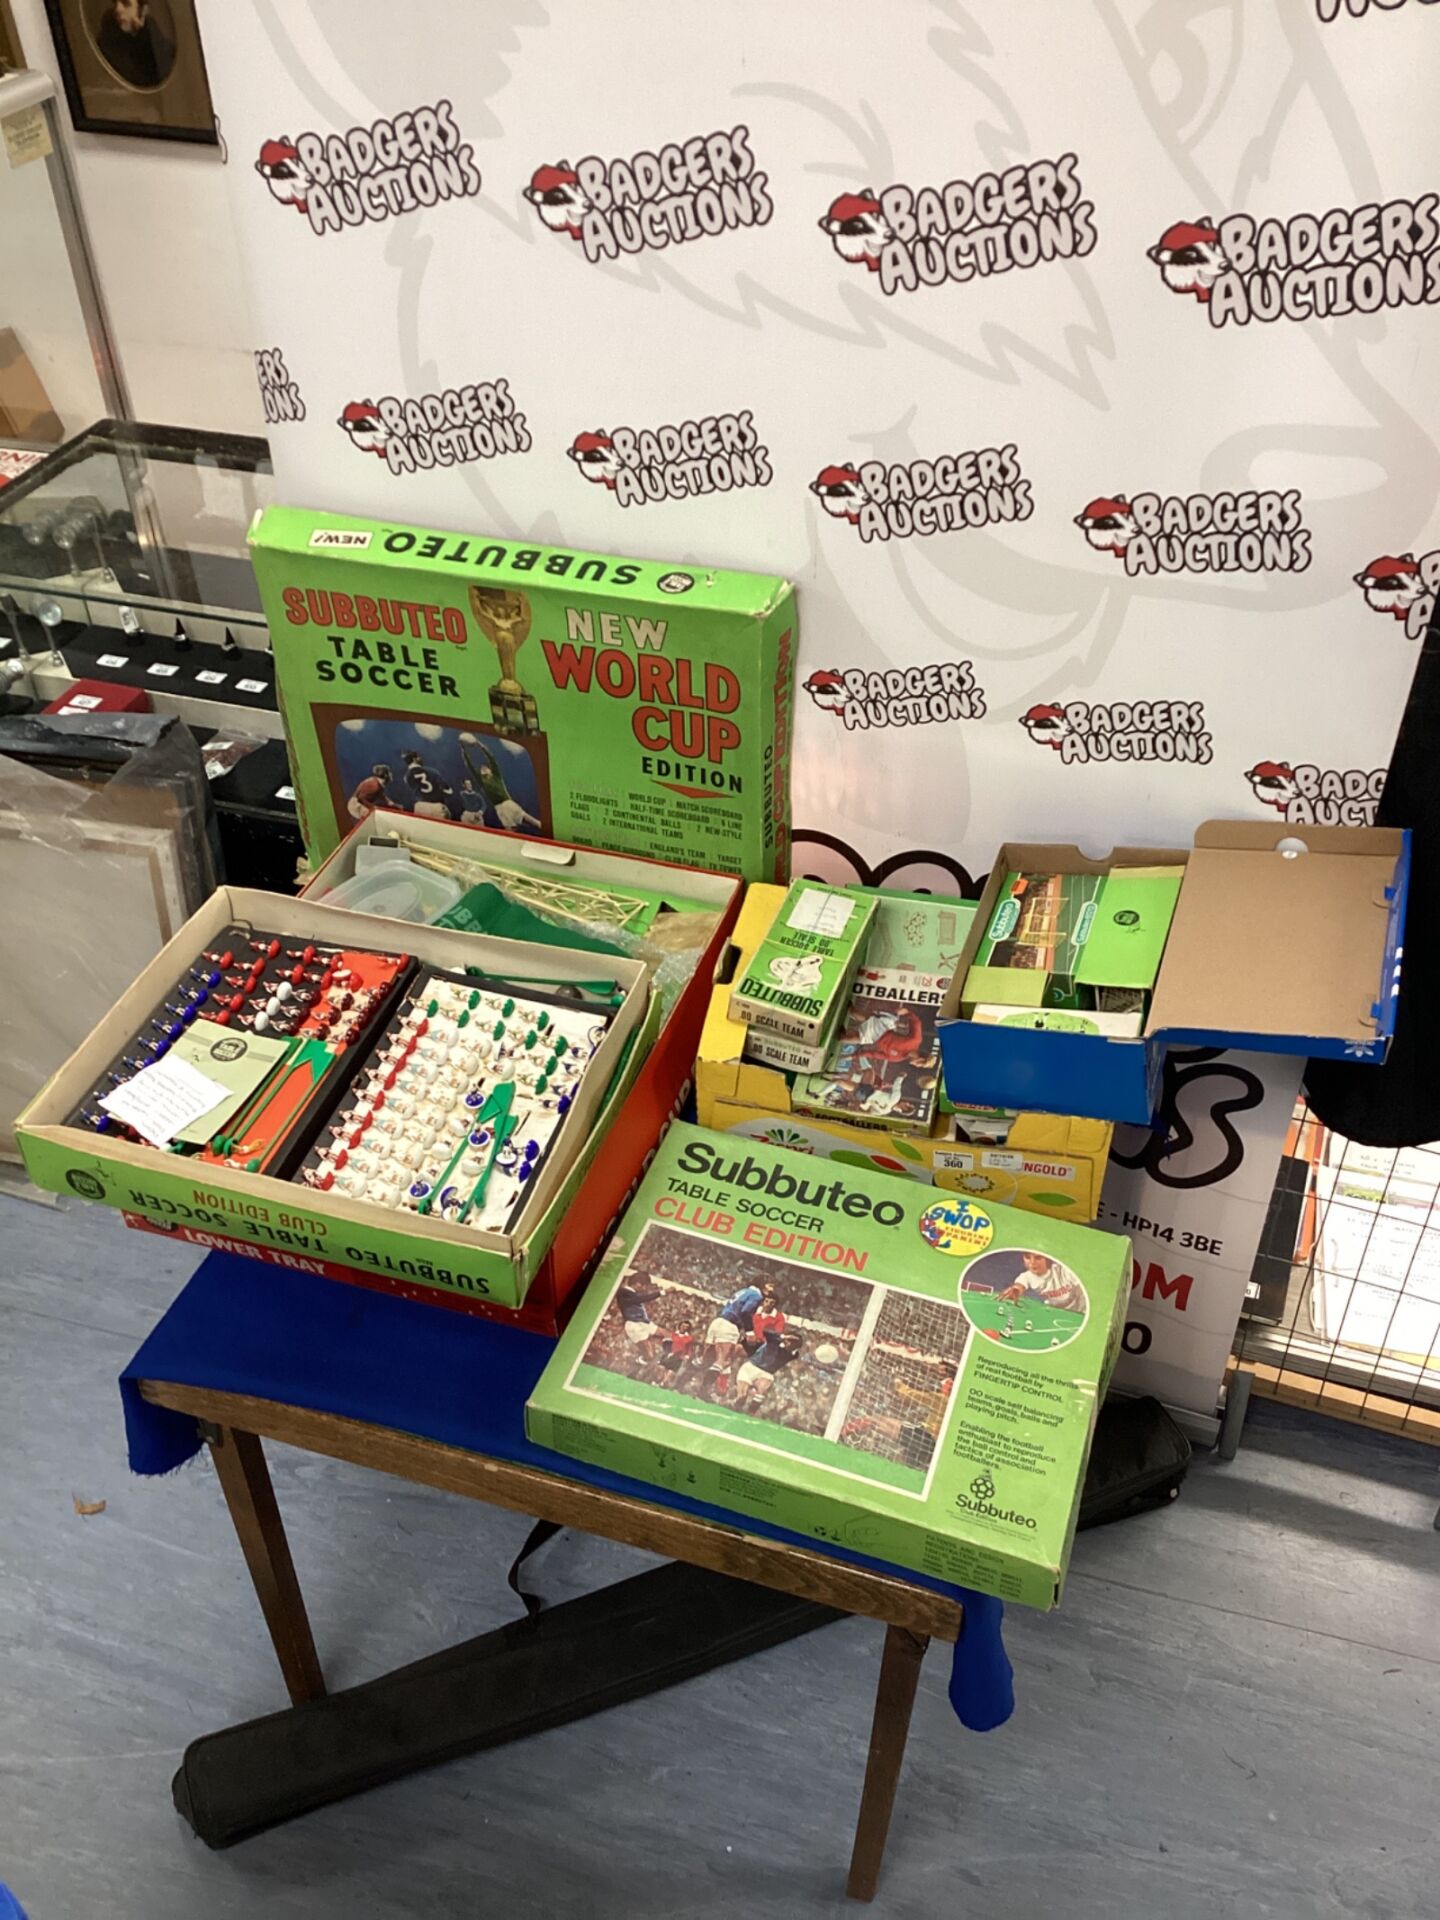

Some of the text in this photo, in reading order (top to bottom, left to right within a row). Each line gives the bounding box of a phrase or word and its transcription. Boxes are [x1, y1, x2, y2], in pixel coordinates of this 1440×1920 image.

[299, 100, 461, 184] BADGERS
[576, 125, 754, 209] BADGERS
[304, 145, 482, 235] AUCTIONS
[878, 153, 1080, 244] BADGERS
[581, 172, 774, 263] AUCTIONS
[1217, 193, 1440, 274] BADGERS
[878, 201, 1097, 295] AUCTIONS
[379, 378, 515, 438] BADGERS
[382, 412, 532, 475] AUCTIONS
[612, 410, 758, 471] BADGERS
[614, 444, 774, 506] AUCTIONS
[857, 444, 1021, 502] BADGERS
[858, 480, 1034, 542] AUCTIONS
[1131, 489, 1302, 537] BADGERS
[314, 535, 367, 546] NEW!
[383, 531, 643, 585] SUBBUTEO
[1124, 528, 1311, 576] AUCTIONS
[283, 586, 468, 645] SUBBUTEO
[565, 606, 668, 652] NEW
[327, 635, 440, 671] TABLE
[315, 659, 461, 698] SOCCER
[540, 639, 741, 715] WORLD
[843, 661, 975, 701] BADGERS
[843, 690, 986, 730] AUCTIONS
[1066, 701, 1205, 735] BADGERS
[632, 705, 742, 765] CUP
[1061, 732, 1213, 764] AUCTIONS
[414, 772, 433, 793] 3
[641, 756, 743, 794] EDITION
[575, 792, 618, 808] FLOODLIGHTS
[667, 808, 710, 824] SCOREBOARD
[727, 820, 742, 830] LINE
[628, 792, 743, 821] WORLD CUP MATCH SCOREBOARD
[764, 744, 774, 849] SUBBUTEO
[570, 802, 590, 812] FLAGS
[613, 809, 656, 826] CONTINENTAL
[660, 818, 681, 829] BALLS
[722, 828, 742, 840] STYLE
[570, 811, 591, 822] GOALS
[608, 818, 658, 836] INTERNATIONAL
[661, 827, 684, 839] TEAMS
[687, 847, 706, 859] TEAM
[717, 854, 742, 864] TARGET
[739, 977, 824, 1018] SUBBUTEO
[755, 1013, 779, 1033] SCALE
[782, 1022, 805, 1039] TEAM
[765, 1046, 786, 1063] SCALE
[788, 1051, 810, 1068] TEAM
[677, 1141, 905, 1226] Subbuteo
[944, 1159, 963, 1169] 360
[192, 1190, 328, 1236] CLUB EDITION
[667, 1177, 825, 1233] TABLE SOCCER
[929, 1206, 990, 1232] SWOP
[957, 1200, 969, 1213] I
[128, 1189, 490, 1294] SUBBUTEO TABLE SOCCER
[183, 1228, 326, 1276] LOWER TRAY
[654, 1196, 870, 1272] CLUB EDITION
[1122, 1211, 1175, 1243] HP14
[1179, 1231, 1223, 1256] 3BE
[974, 1370, 1063, 1403] FINGERTIP CONTROL
[978, 1355, 1029, 1377] Reproducing
[1030, 1370, 1040, 1380] all
[1041, 1372, 1054, 1384] the
[985, 1365, 1001, 1375] real
[1002, 1370, 1033, 1385] football
[1033, 1380, 1044, 1389] by
[965, 1402, 1019, 1424] playing pitch.
[984, 1393, 1006, 1405] scale
[1007, 1399, 1023, 1409] self
[1023, 1402, 1064, 1423] balancing
[1020, 1410, 1041, 1423] balls
[1042, 1417, 1058, 1428] and
[957, 1435, 1036, 1466] the ball control and
[958, 1429, 1056, 1463] enthusiast to reproduce
[960, 1420, 1044, 1452] Enabling the football
[953, 1449, 1001, 1470] footballers.
[955, 1442, 983, 1457] tactics
[995, 1457, 1046, 1476] association
[955, 1493, 1038, 1530] Subbuteo
